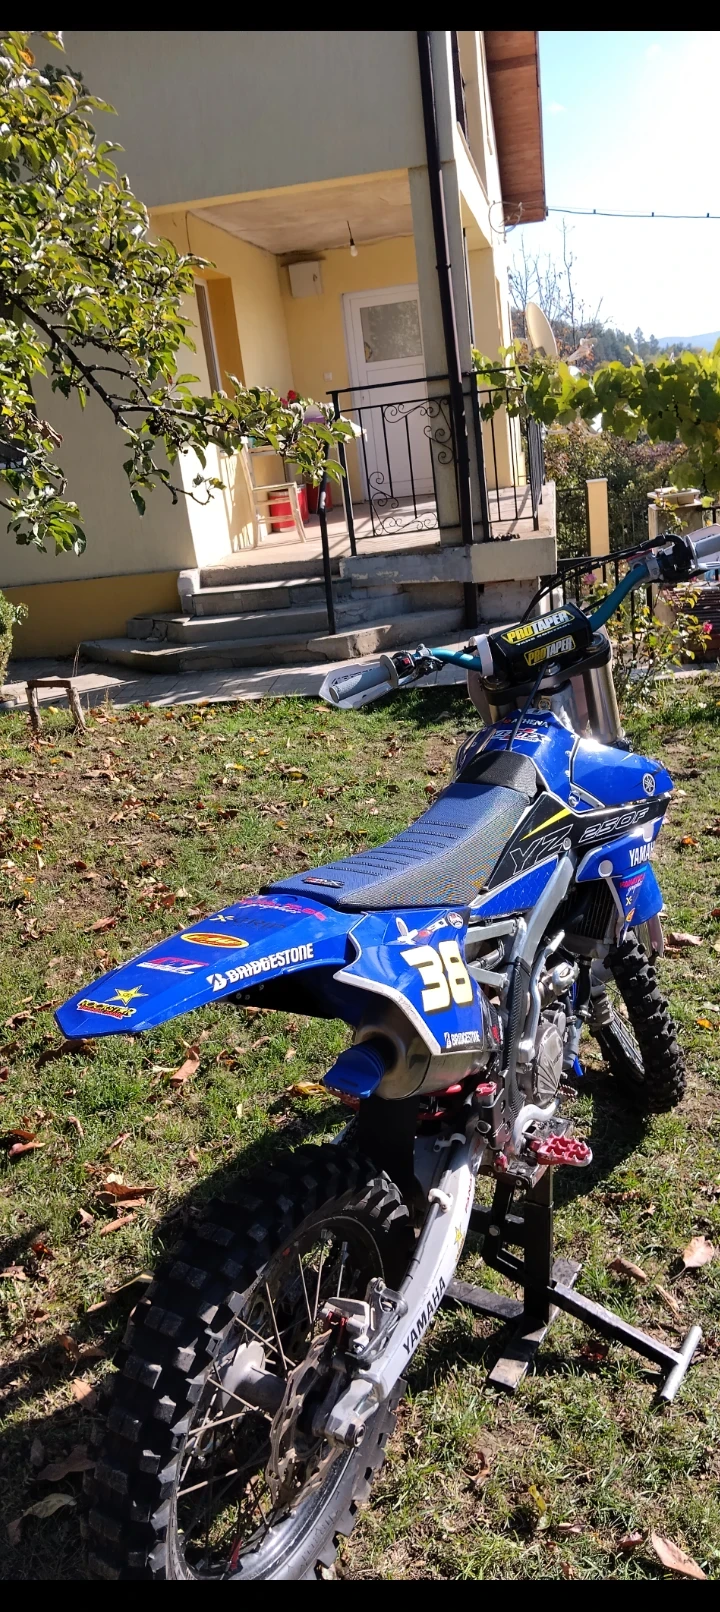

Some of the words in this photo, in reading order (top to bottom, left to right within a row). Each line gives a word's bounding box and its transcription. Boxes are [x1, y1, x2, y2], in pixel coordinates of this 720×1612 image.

[506, 611, 570, 642] PROTAPER
[528, 637, 573, 663] PROTAPER
[511, 718, 548, 728] AHENA
[509, 823, 574, 876] YZ
[578, 808, 650, 844] 250F
[225, 943, 314, 983] BRIDGESTONE
[400, 940, 473, 1014] 38
[403, 1276, 446, 1354] YAMAHA
